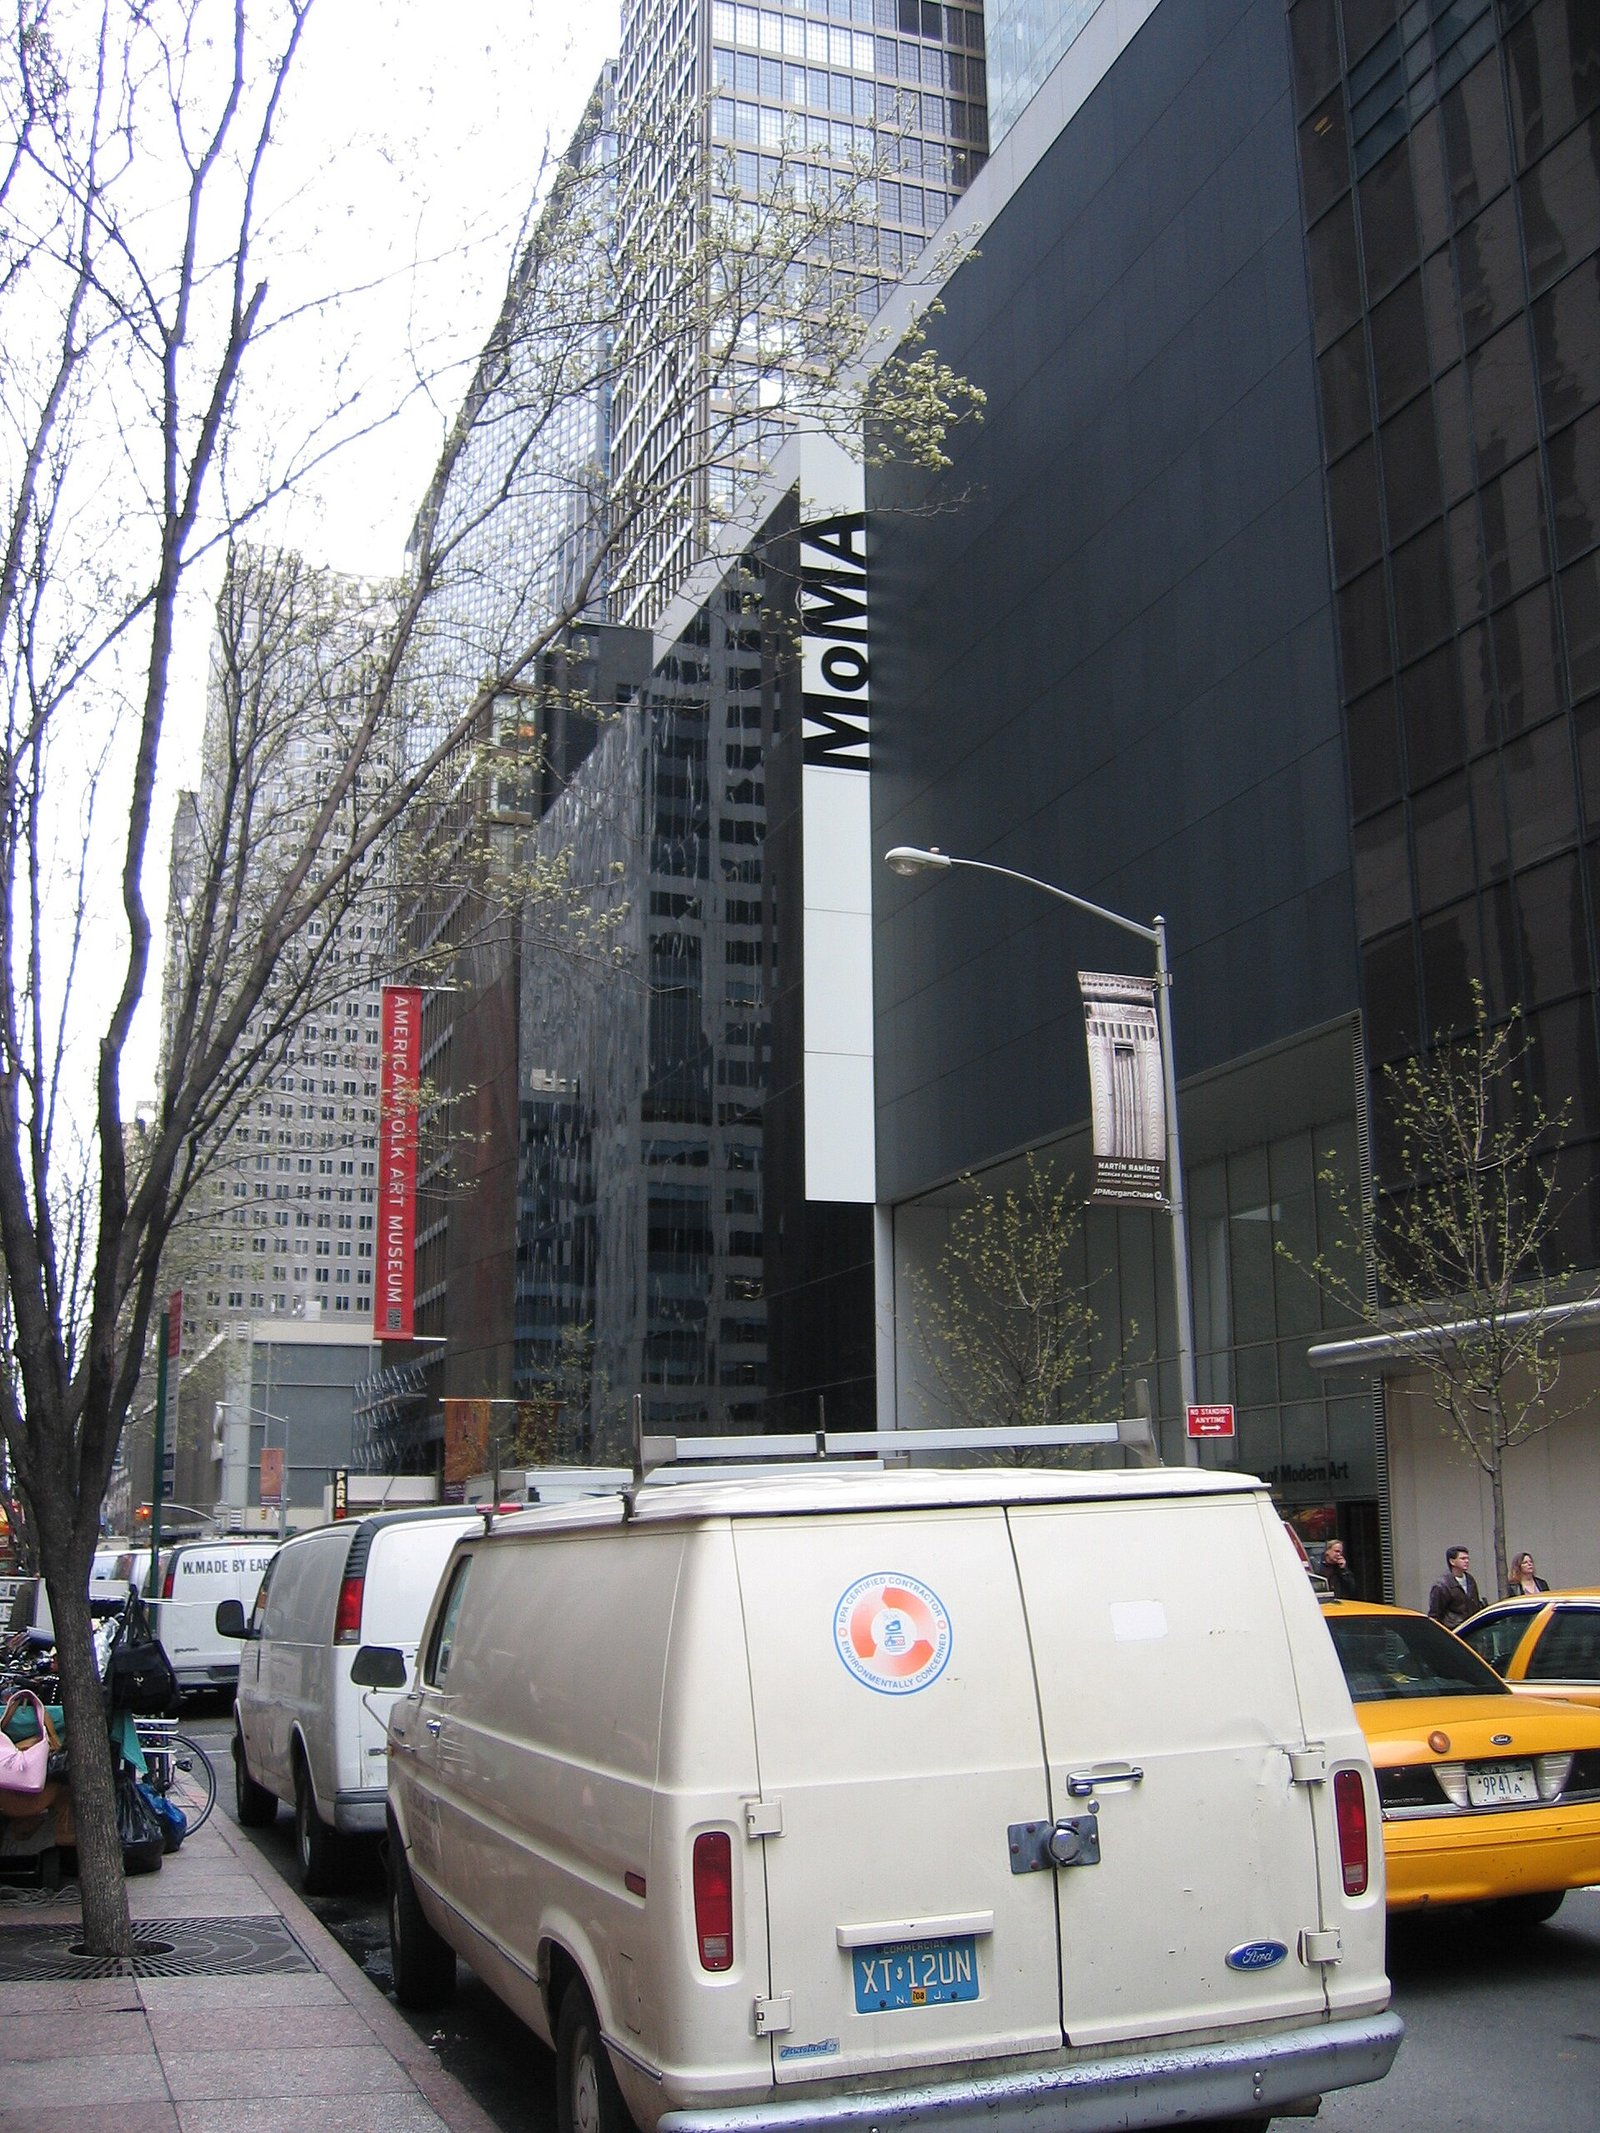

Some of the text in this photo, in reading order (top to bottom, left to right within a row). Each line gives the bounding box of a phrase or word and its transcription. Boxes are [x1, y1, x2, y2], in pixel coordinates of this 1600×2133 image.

[800, 512, 870, 772] MoMA
[387, 996, 409, 1303] AMERICAN FOLK ART MUSEUM
[1093, 1188, 1154, 1199] JPMorganChase
[1195, 1416, 1226, 1424] ANYTIME
[1201, 1408, 1230, 1416] STANDING
[1281, 1463, 1326, 1482] Modern
[1329, 1461, 1349, 1480] Art
[336, 1471, 346, 1508] PARK
[232, 1560, 245, 1572] BY
[250, 1559, 272, 1572] EAR
[839, 1577, 942, 1623] EPA CERTIFIED CONTRACTOR
[841, 1633, 947, 1689] ENVIRONMENTALLY CONCERNED
[883, 1940, 946, 1955] COMMERCIAL
[1242, 1946, 1274, 1963] Ford
